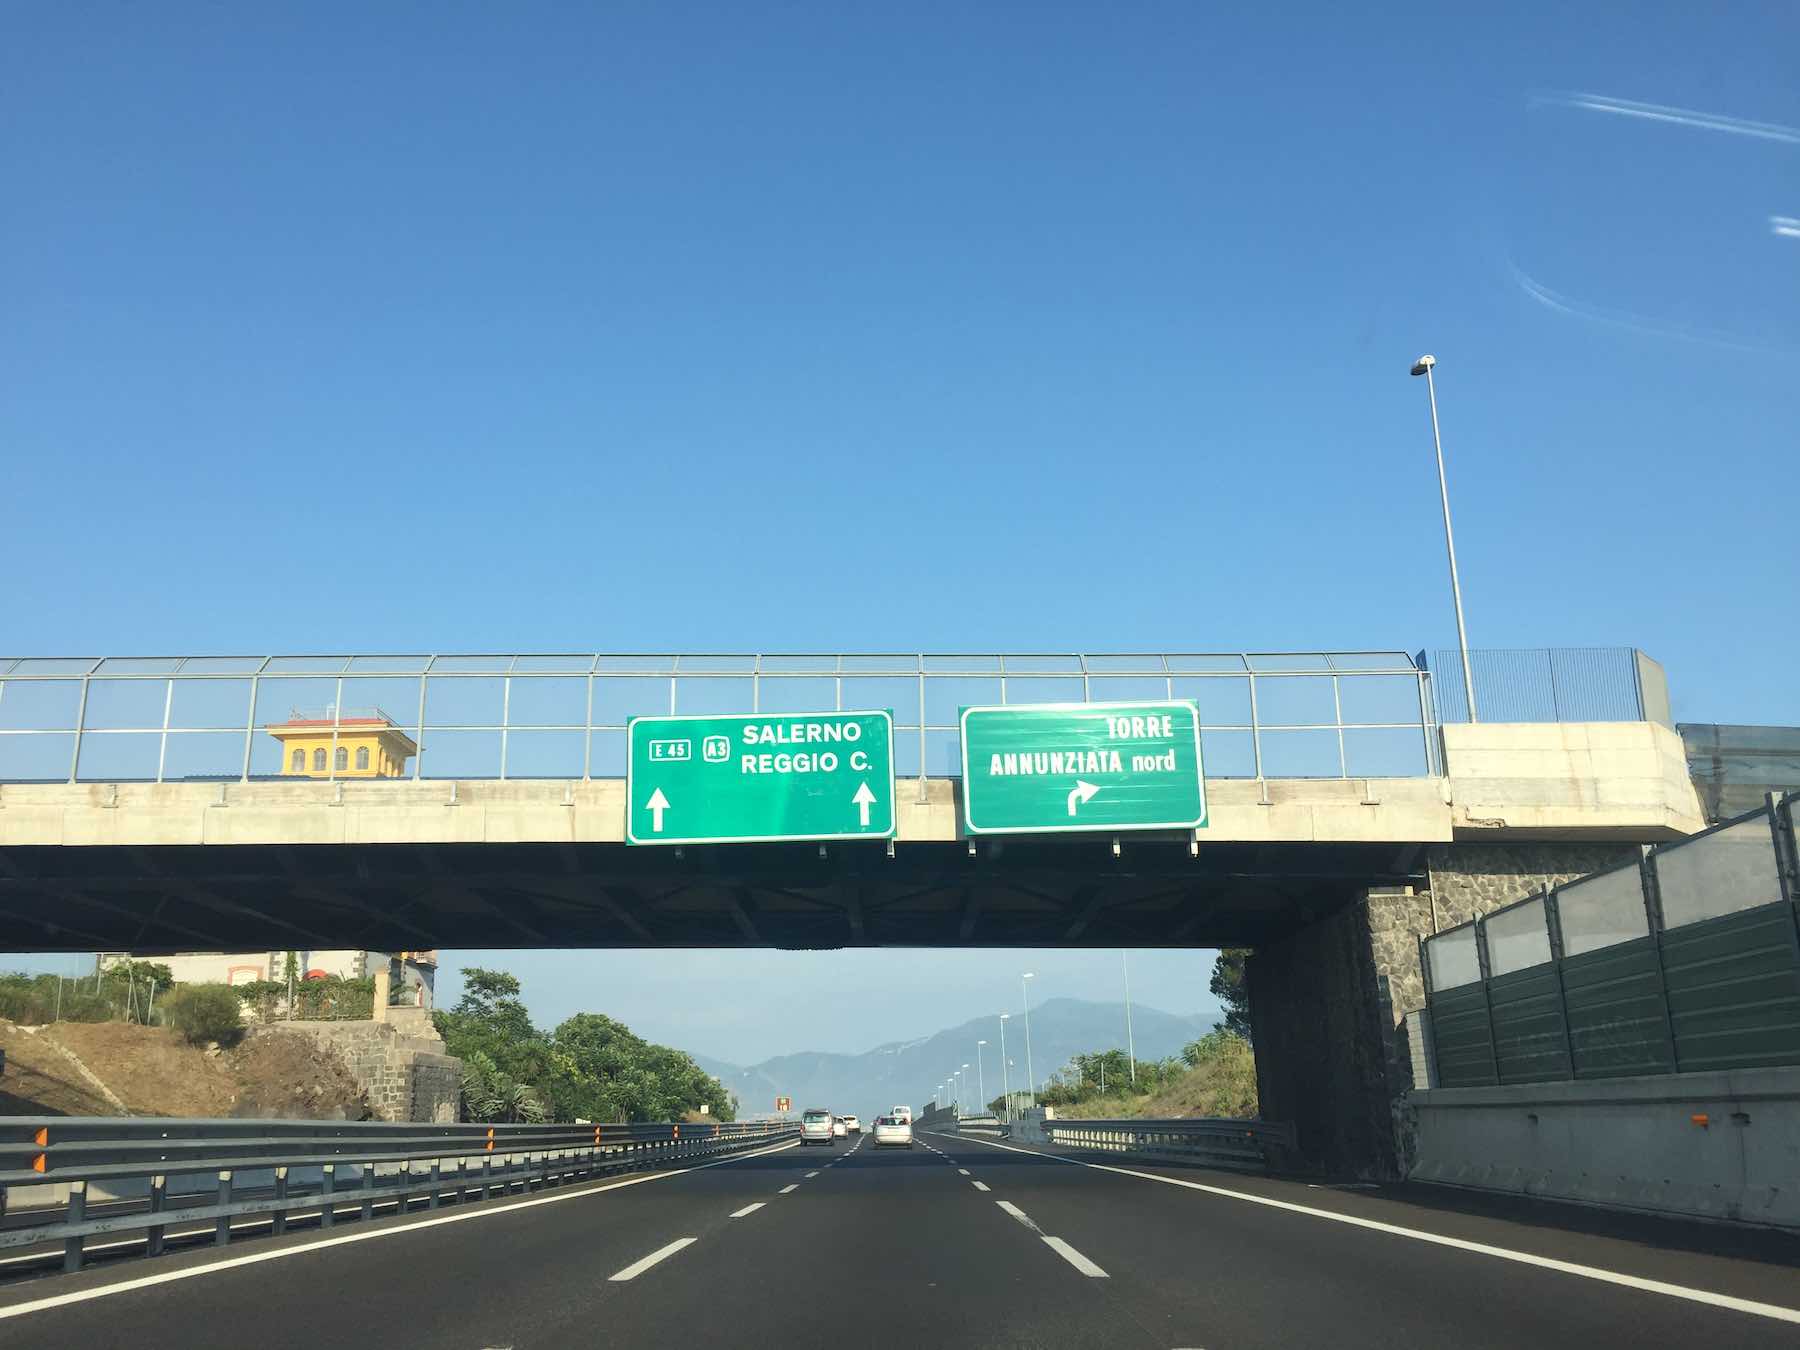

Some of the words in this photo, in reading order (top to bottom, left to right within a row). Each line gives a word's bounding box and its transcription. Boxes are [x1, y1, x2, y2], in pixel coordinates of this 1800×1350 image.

[742, 722, 862, 745] SALERNO
[1107, 716, 1174, 739] TORRE
[667, 744, 685, 757] 45
[707, 743, 727, 757] A3
[741, 752, 838, 774] REGGIO
[850, 751, 873, 771] C.
[990, 751, 1123, 776] ANNUNZIATA
[1132, 749, 1176, 772] nord
